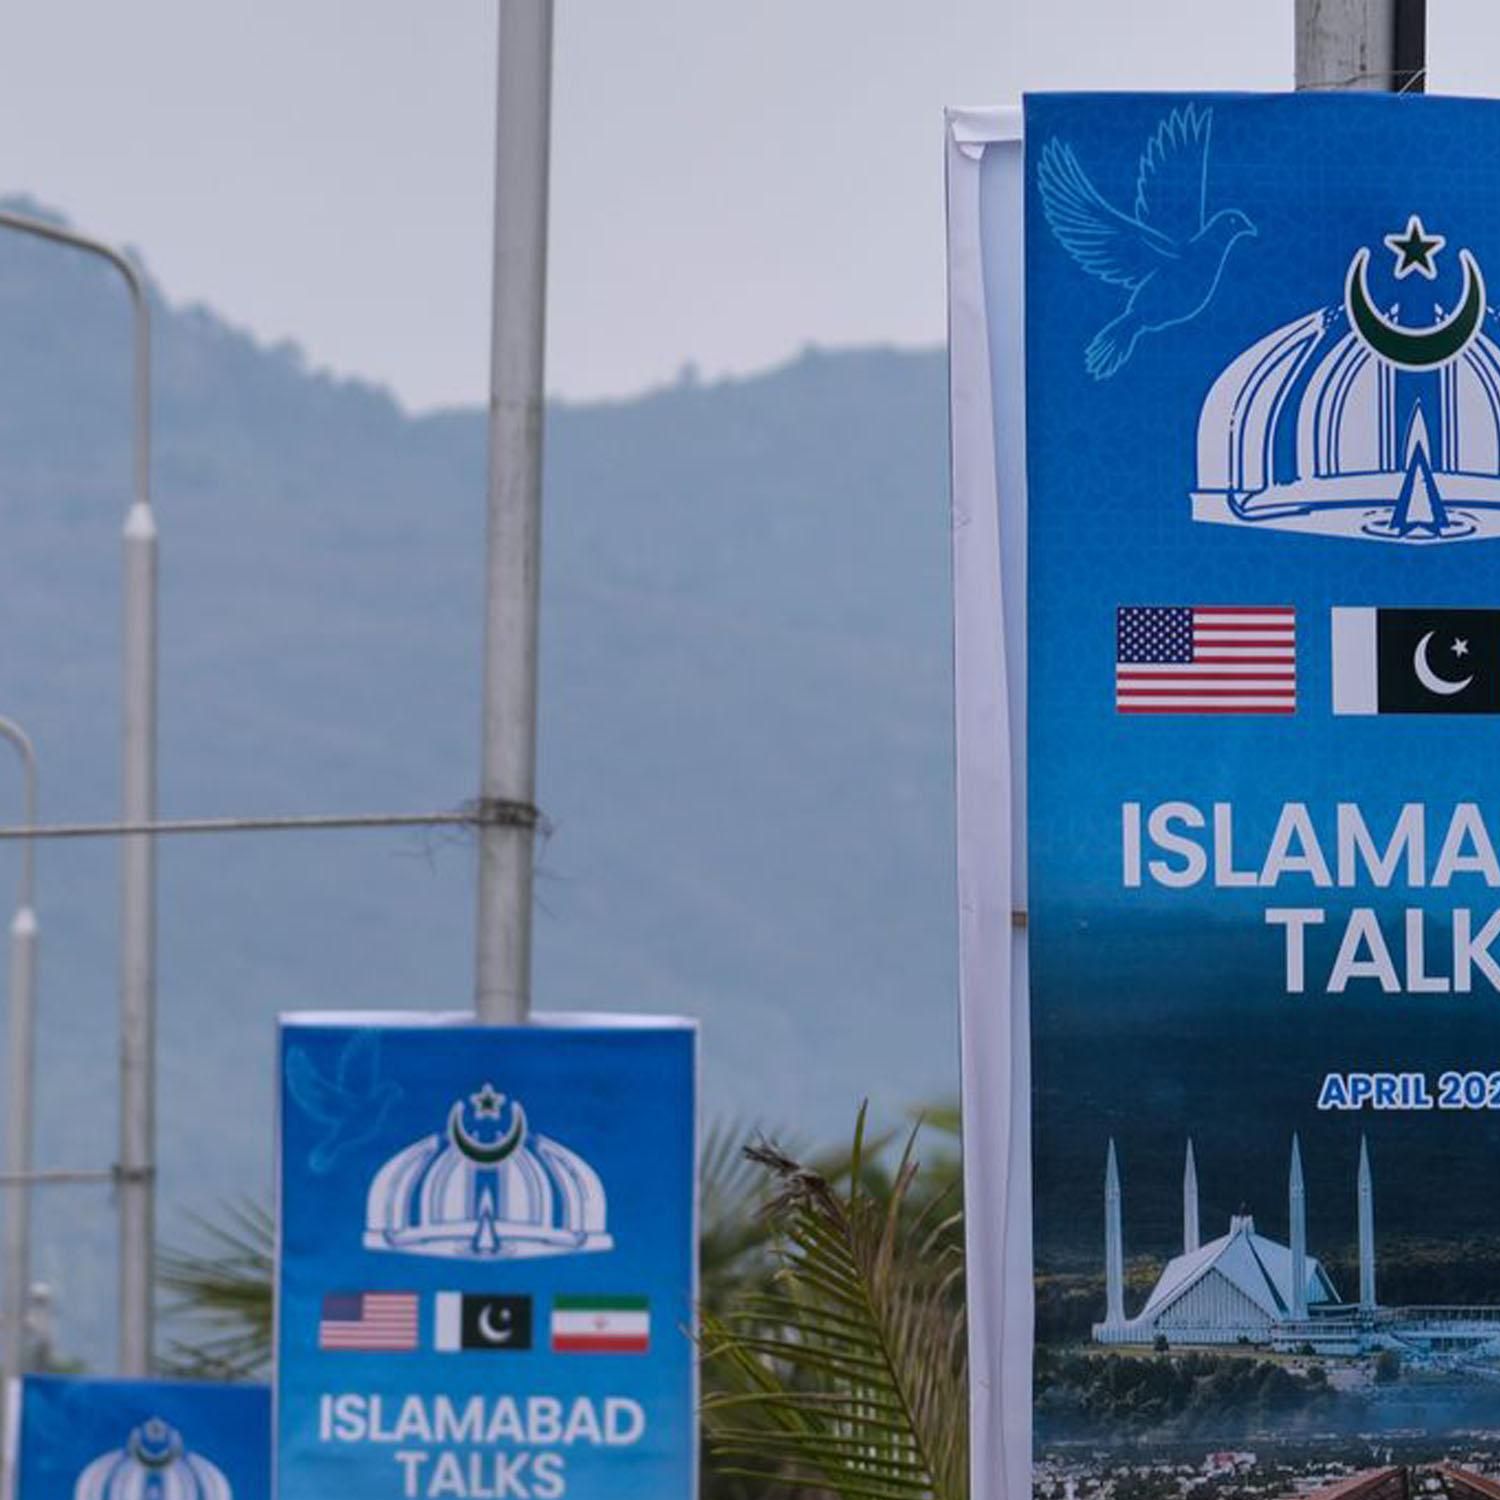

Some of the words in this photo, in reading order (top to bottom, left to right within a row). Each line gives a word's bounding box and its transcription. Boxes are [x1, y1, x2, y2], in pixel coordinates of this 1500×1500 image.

[1317, 1073, 1433, 1109] APRIL
[319, 1394, 646, 1445] ISLAMABAD
[394, 1450, 566, 1500] TALKS
